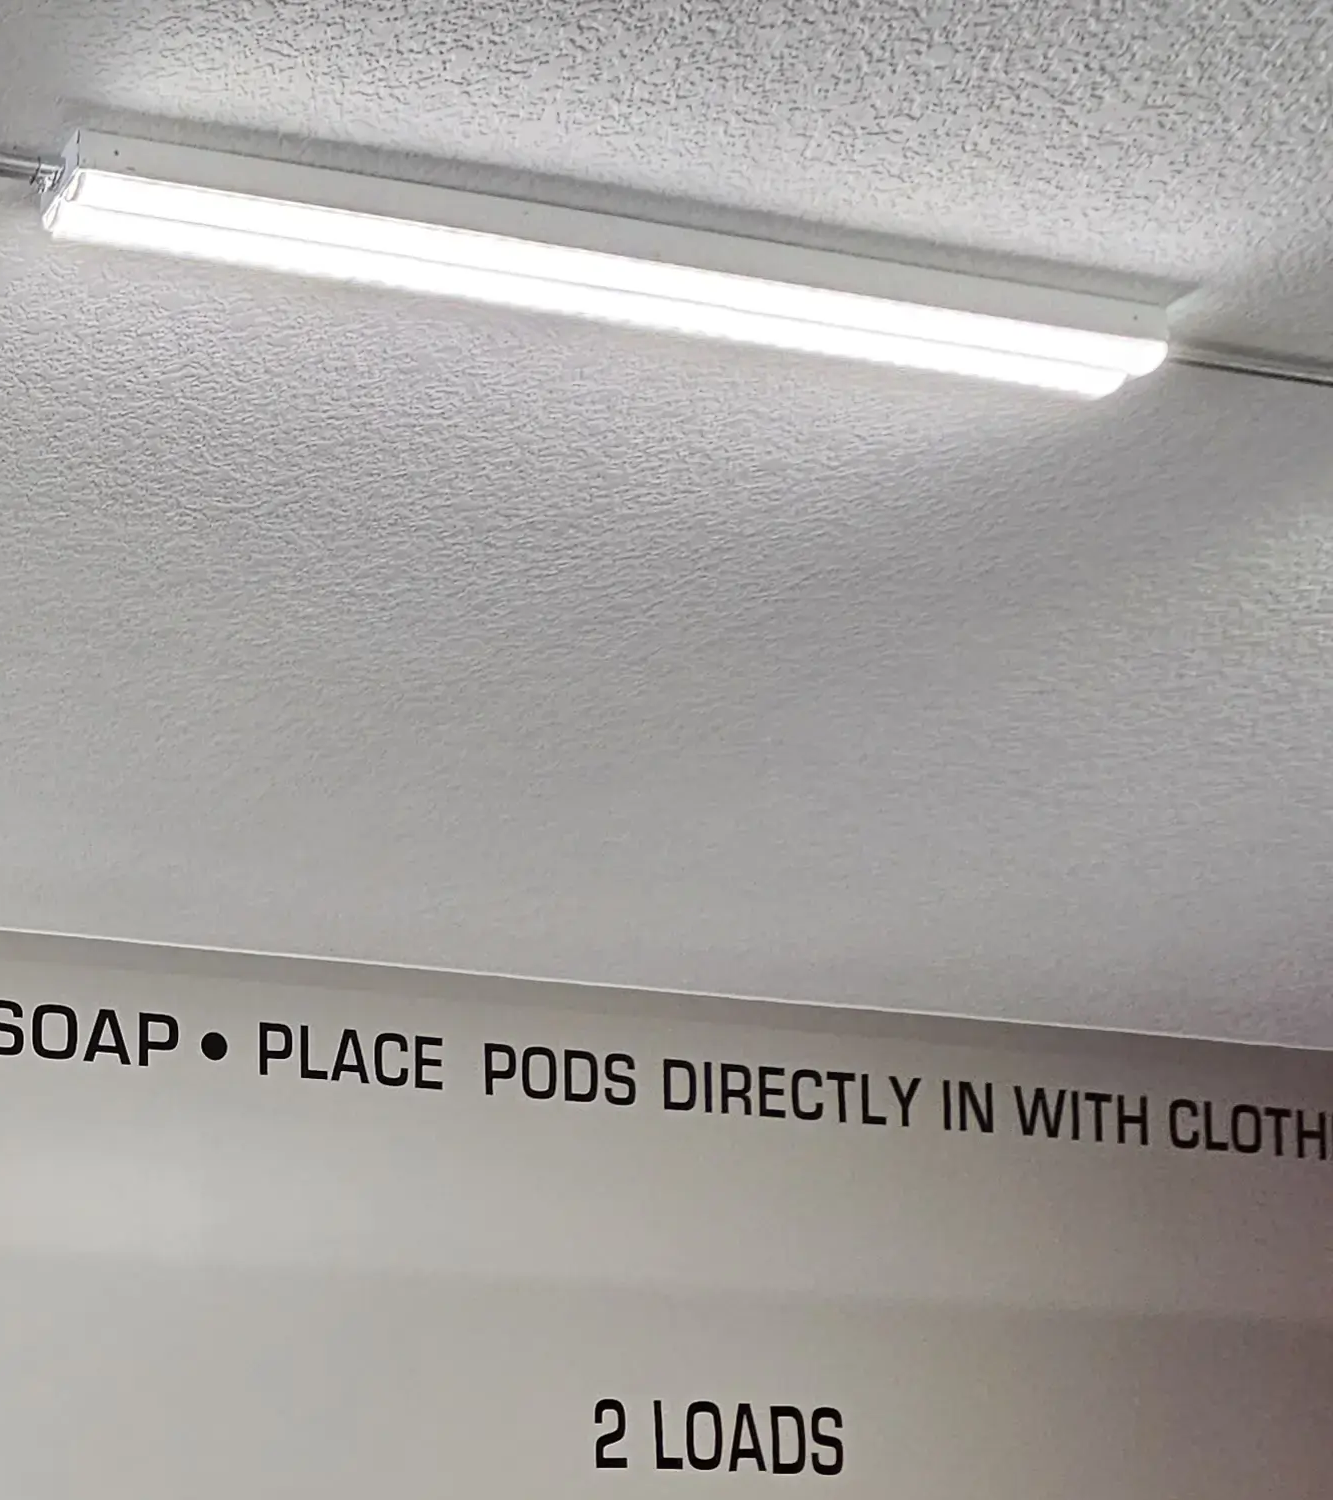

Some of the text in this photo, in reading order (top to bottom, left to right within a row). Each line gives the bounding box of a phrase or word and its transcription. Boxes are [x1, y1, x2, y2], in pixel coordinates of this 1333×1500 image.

[259, 1021, 443, 1090] PLACE
[484, 1042, 637, 1106] PODS
[662, 1058, 922, 1128] DIRECTLY
[942, 1079, 994, 1134] IN
[1012, 1085, 1149, 1147] WITH
[1168, 1098, 1333, 1161] CLOTH
[594, 1398, 844, 1476] 2 LOADS
